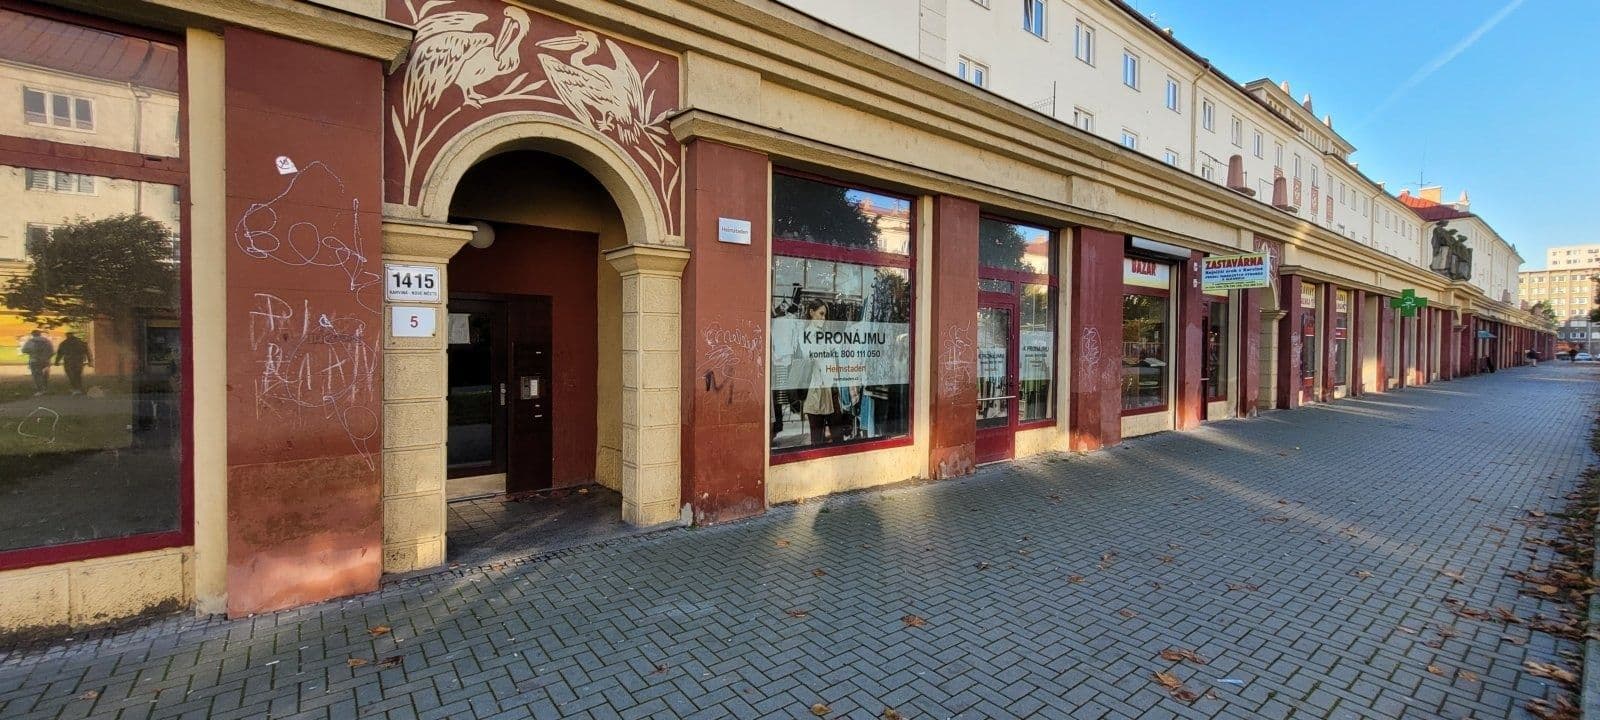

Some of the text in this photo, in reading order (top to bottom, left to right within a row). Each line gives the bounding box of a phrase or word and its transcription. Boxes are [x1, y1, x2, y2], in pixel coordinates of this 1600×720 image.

[1131, 259, 1156, 276] BAZAR
[1205, 256, 1263, 269] ZASTAVÁRNA
[392, 272, 434, 289] 1415
[410, 315, 419, 328] 5
[803, 329, 886, 345] K PRONÁJMU
[809, 349, 881, 358] kontakt: 800 111 050
[826, 364, 866, 373] Heimstaden
